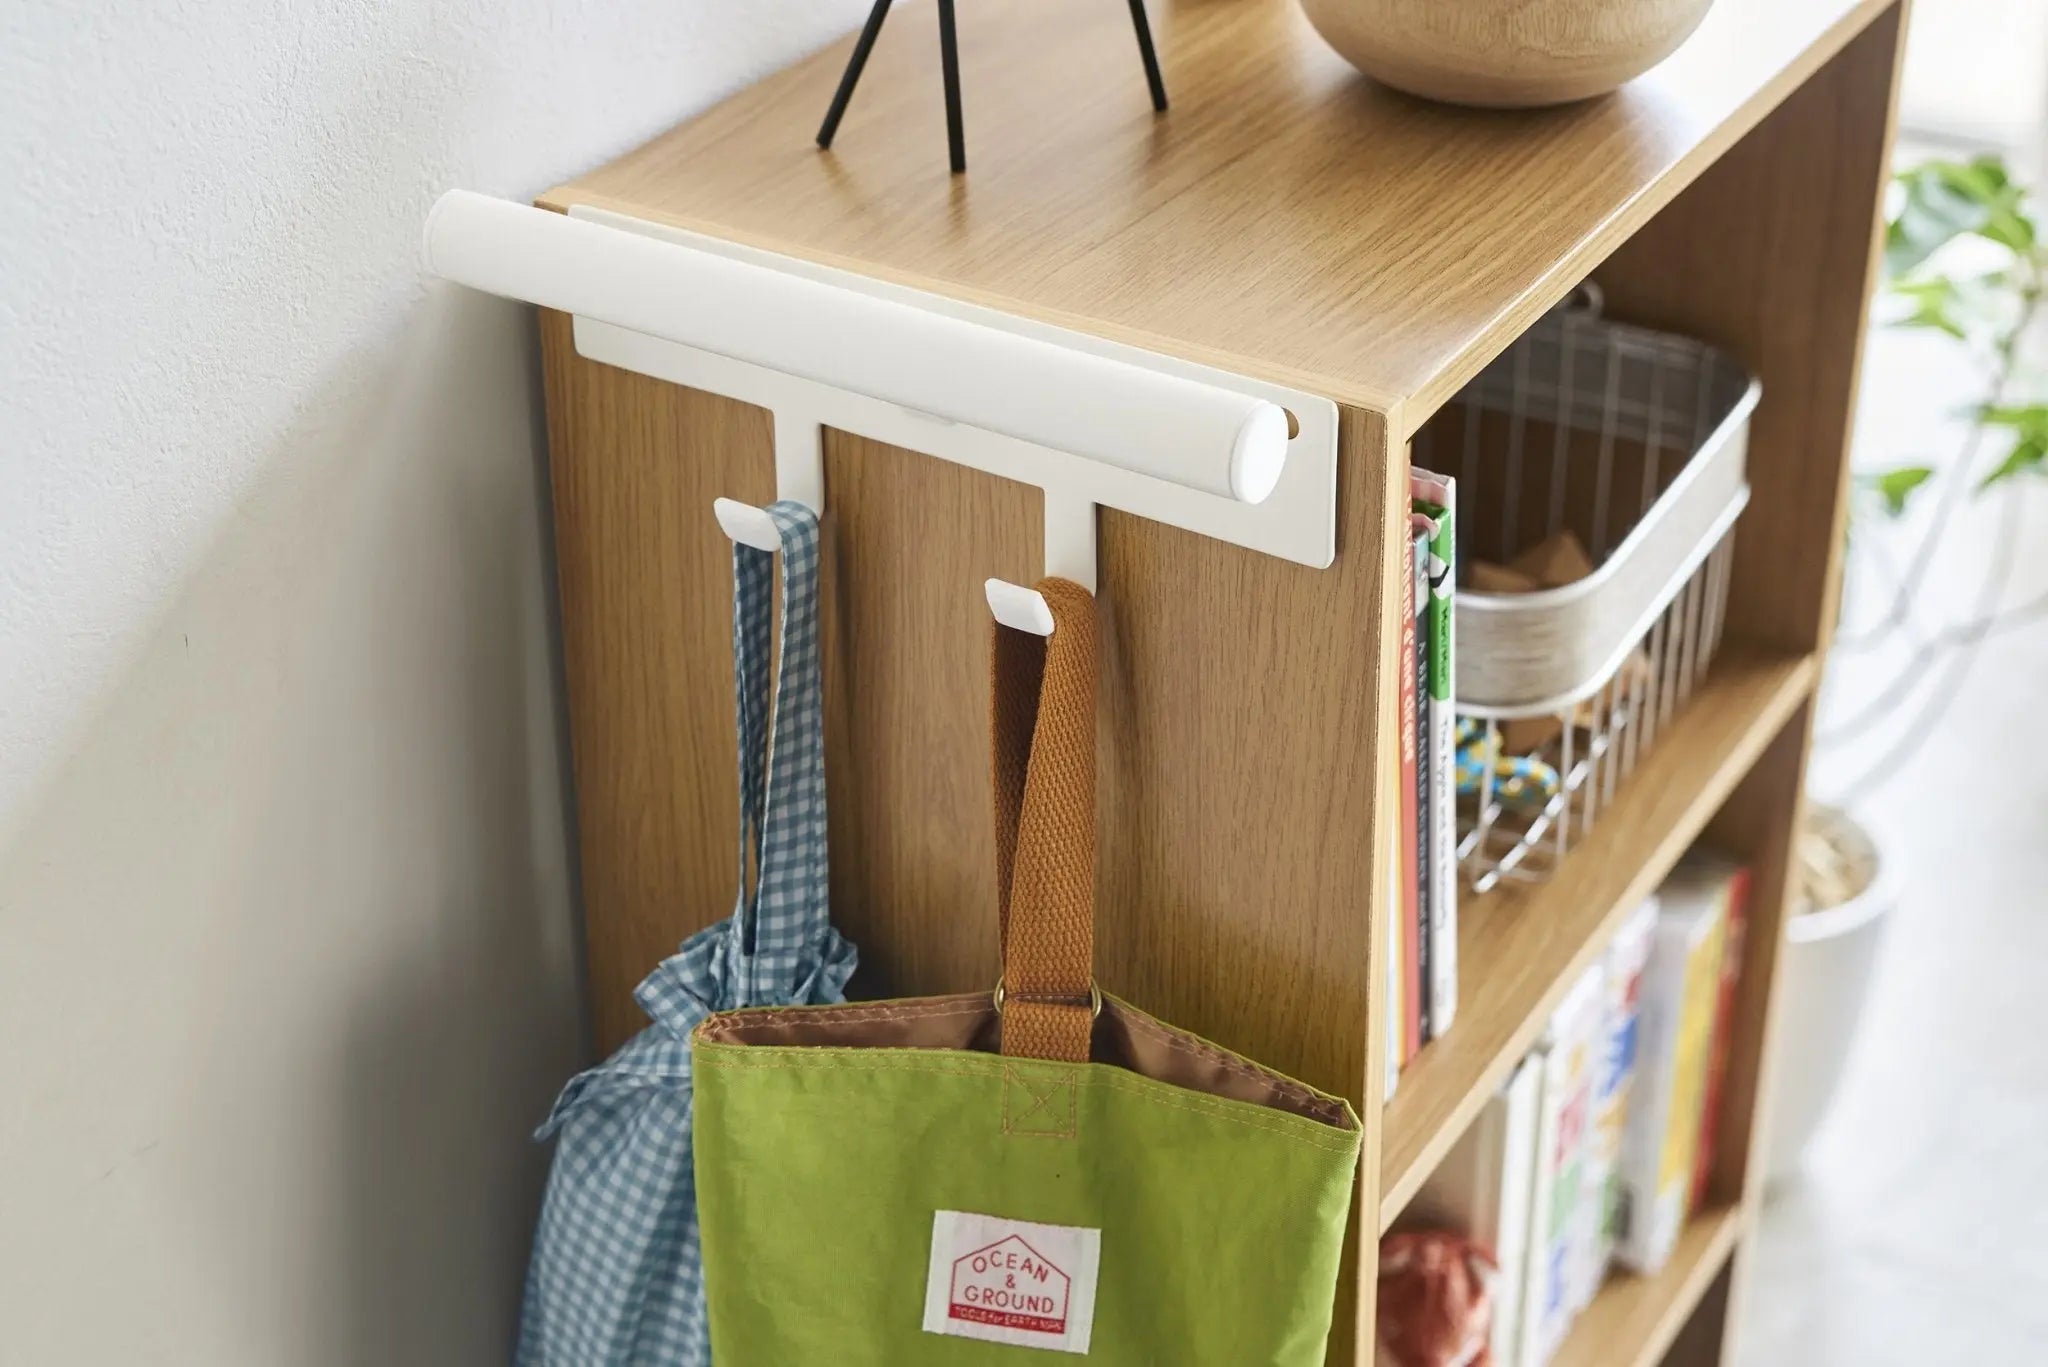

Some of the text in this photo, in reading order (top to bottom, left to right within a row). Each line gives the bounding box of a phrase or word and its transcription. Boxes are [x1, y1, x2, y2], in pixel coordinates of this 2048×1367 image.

[972, 1250, 1049, 1283] OCEAN
[1005, 1273, 1016, 1289] &
[964, 1285, 1054, 1314] GROUND
